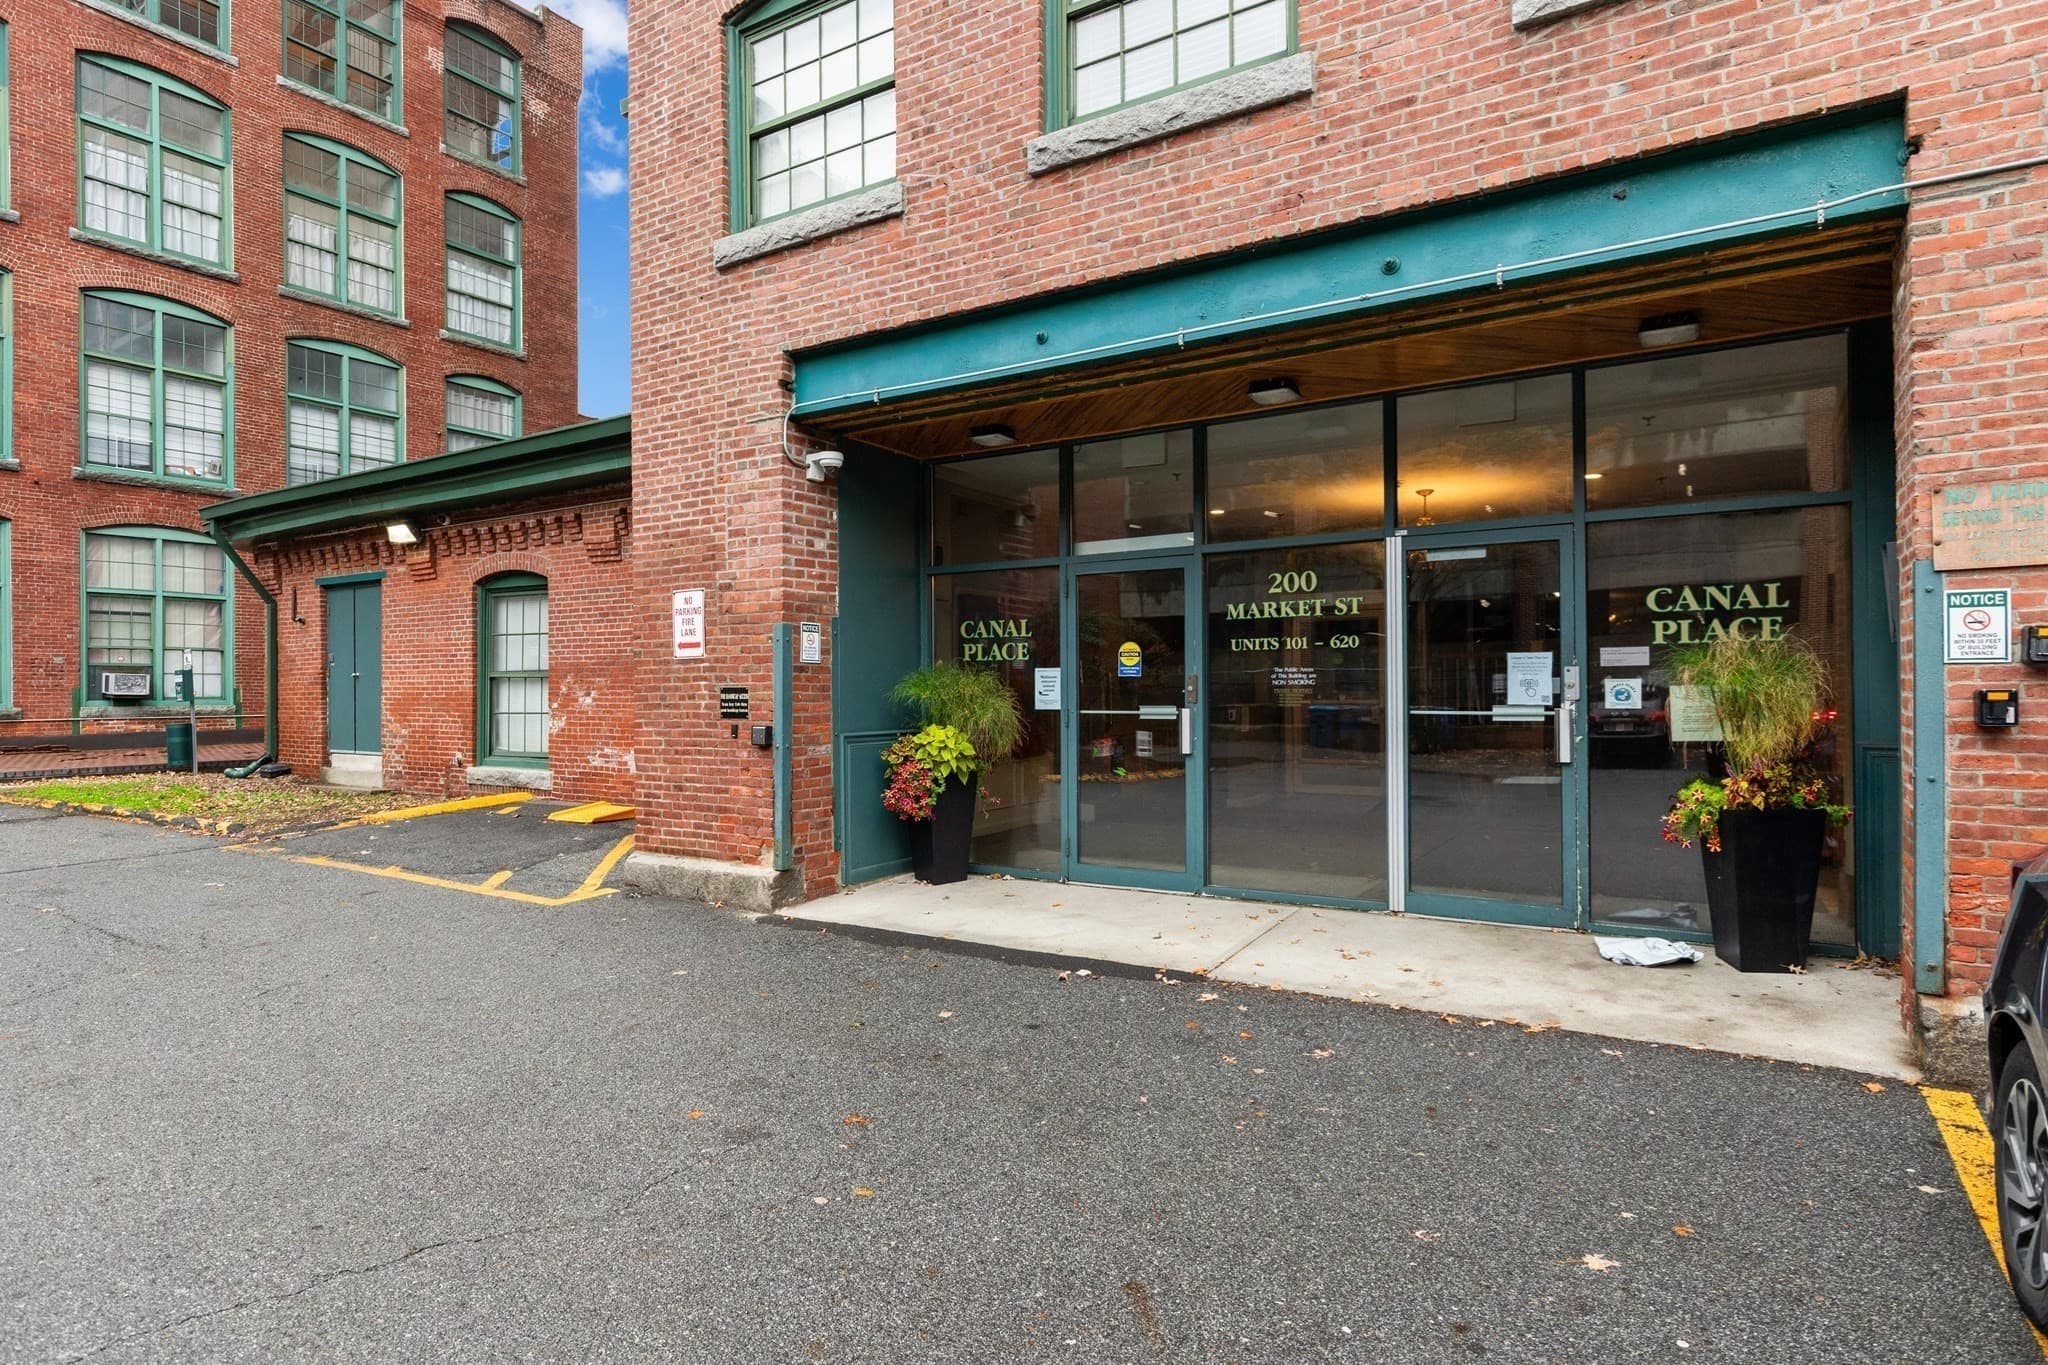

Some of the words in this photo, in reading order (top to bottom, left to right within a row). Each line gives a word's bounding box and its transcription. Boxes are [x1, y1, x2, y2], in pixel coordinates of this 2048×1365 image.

[1945, 487, 1976, 505] NO
[1268, 570, 1318, 594] 200
[684, 596, 693, 605] NO
[1645, 582, 1790, 613] CANAL
[1950, 593, 2005, 606] NOTICE
[675, 606, 702, 616] PARKING
[1226, 599, 1326, 621] MARKET
[1334, 597, 1363, 616] ST
[681, 617, 695, 626] FIRE
[802, 623, 820, 633] NOTICE
[960, 618, 1033, 639] CANAL
[680, 628, 697, 637] LANE
[1652, 616, 1784, 645] PLACE
[1231, 637, 1279, 651] UNITS
[1284, 637, 1308, 650] 101
[1330, 635, 1360, 649] 620
[962, 642, 1030, 662] PLACE
